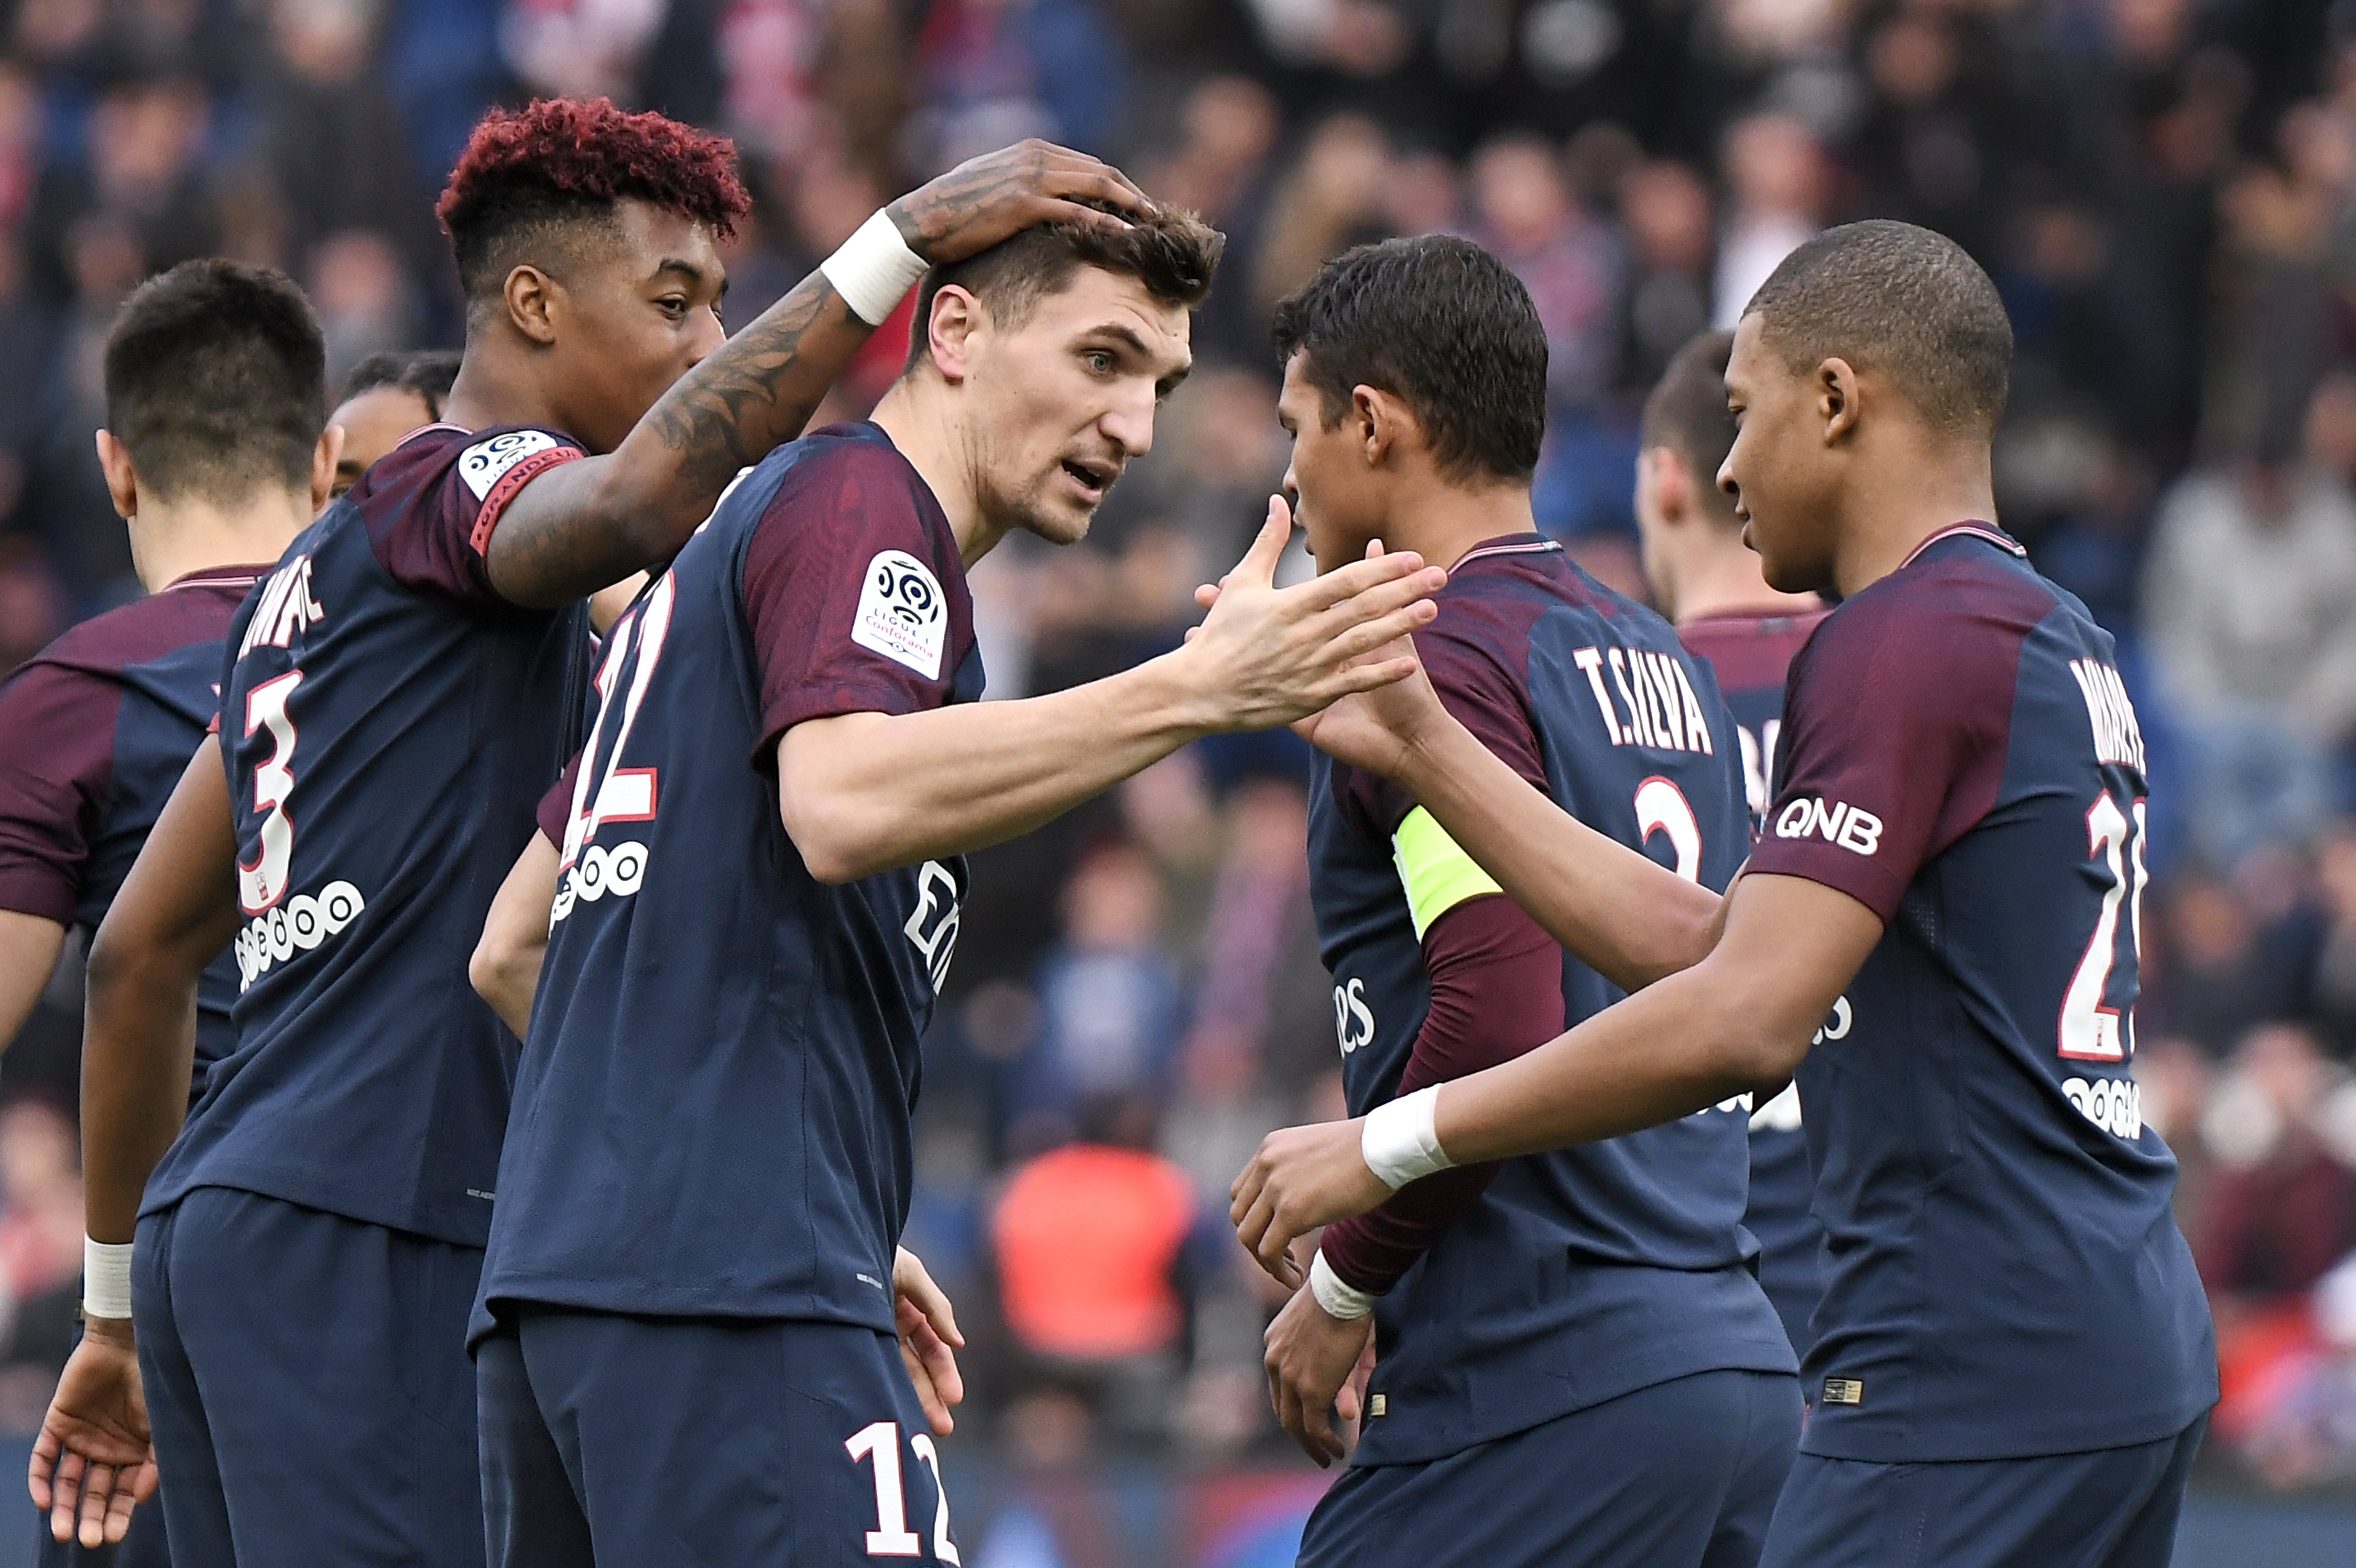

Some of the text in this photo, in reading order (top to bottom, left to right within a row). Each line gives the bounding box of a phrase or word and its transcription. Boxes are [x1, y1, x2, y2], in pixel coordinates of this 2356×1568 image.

[866, 615, 934, 658] Conforama
[874, 608, 916, 637] LIGUE
[1572, 646, 1713, 756] T.SILVA
[240, 669, 304, 916] 3
[1775, 797, 1884, 856] QNB
[2057, 789, 2148, 1059] 2
[843, 1420, 961, 1568] 12
